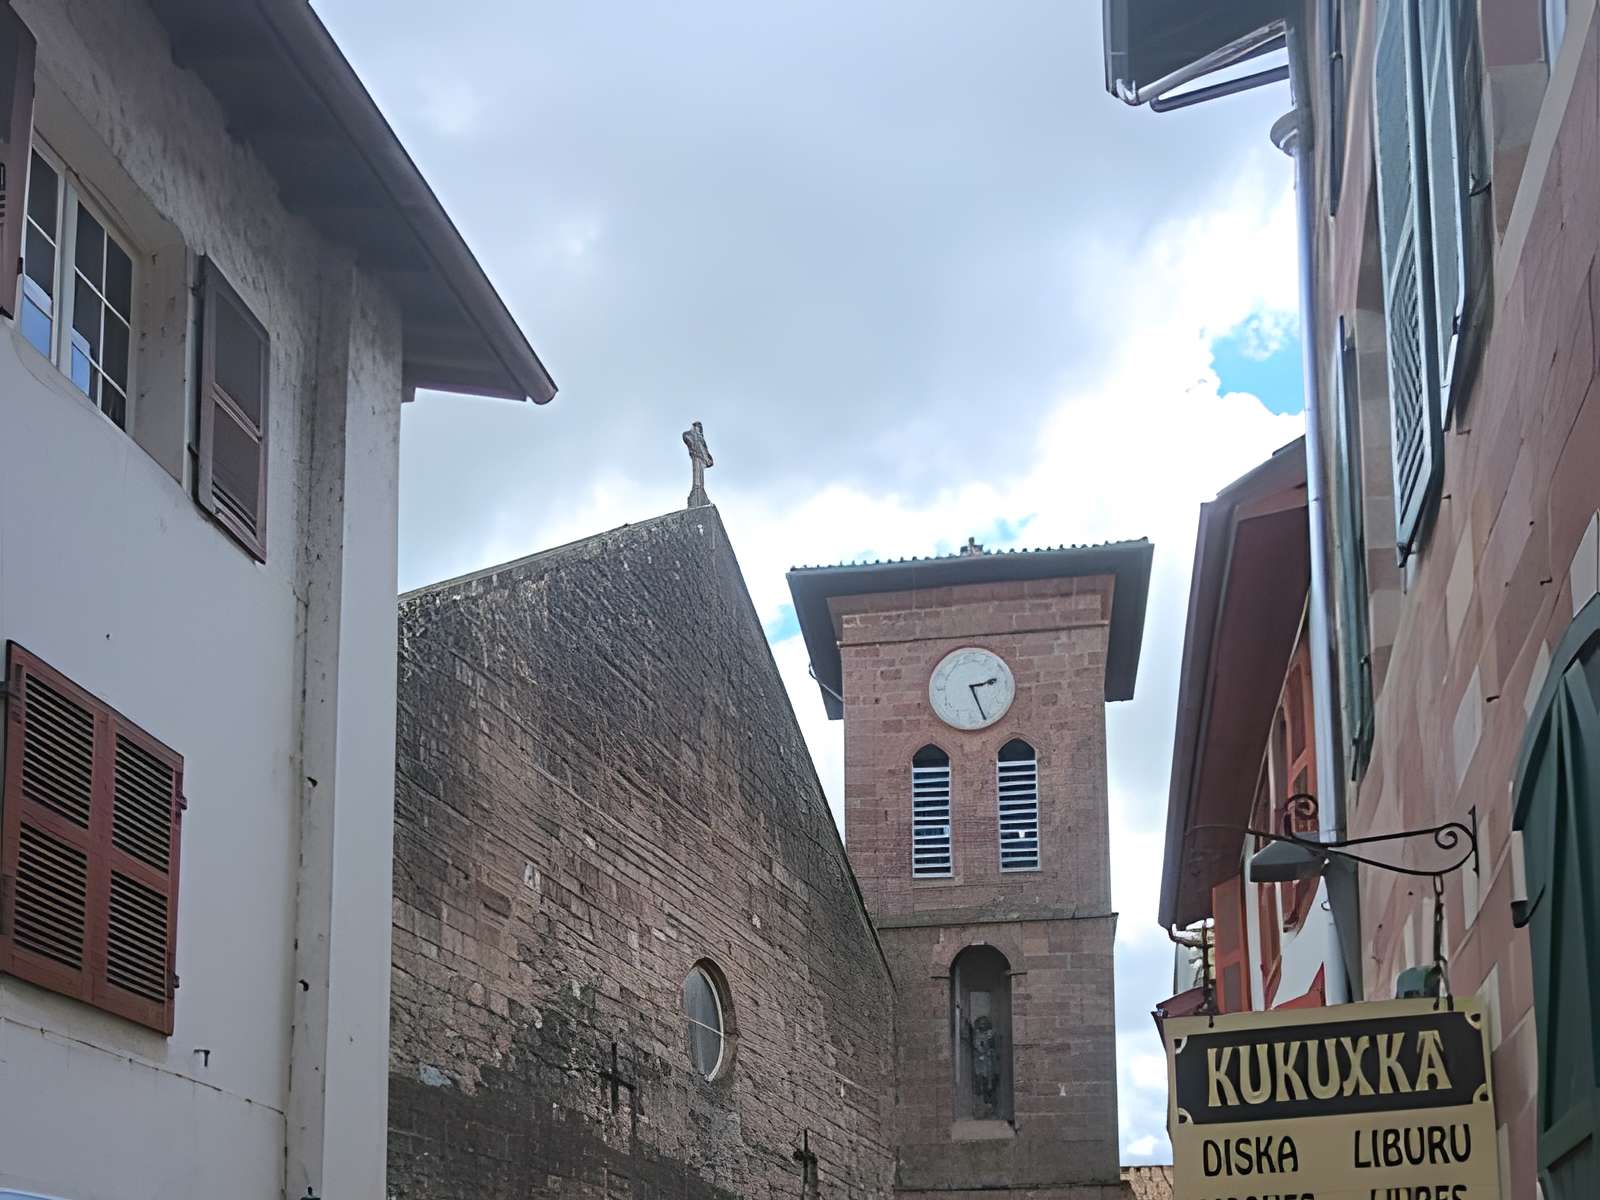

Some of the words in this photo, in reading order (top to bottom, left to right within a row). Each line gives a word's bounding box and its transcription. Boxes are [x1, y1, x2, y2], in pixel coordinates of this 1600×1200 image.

[1207, 1031, 1452, 1107] KUKUXKA
[1203, 1135, 1299, 1177] DISKA
[1354, 1124, 1472, 1168] LIBURU
